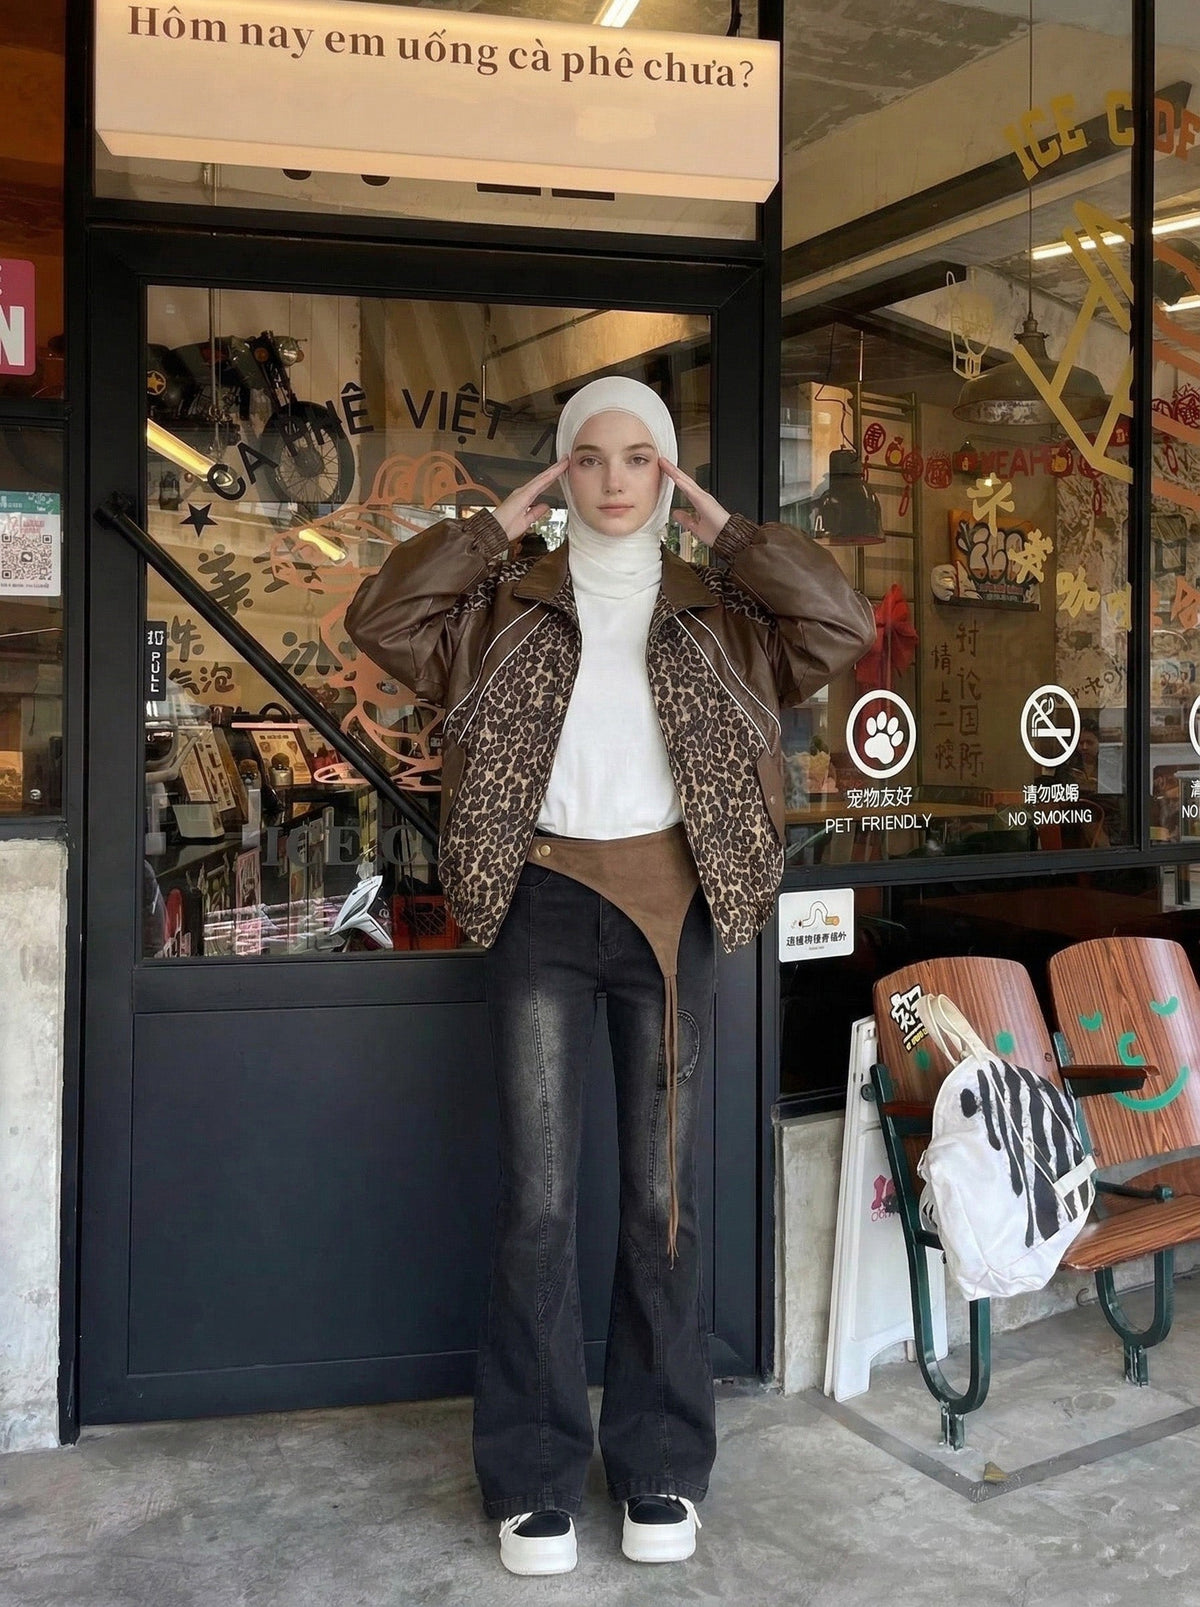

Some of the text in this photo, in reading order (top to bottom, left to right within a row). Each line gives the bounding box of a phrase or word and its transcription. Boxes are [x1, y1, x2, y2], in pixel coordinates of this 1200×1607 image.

[128, 5, 754, 88] Hôm nay em uống cà phê chưa?
[1003, 93, 1088, 181] ICE
[402, 383, 511, 445] VIỆT
[150, 651, 161, 693] PULL
[846, 786, 913, 809] 宠物友好
[1182, 804, 1199, 819] NO
[825, 813, 932, 834] PET FRIENDLY
[1008, 809, 1092, 826] NO SMOKING
